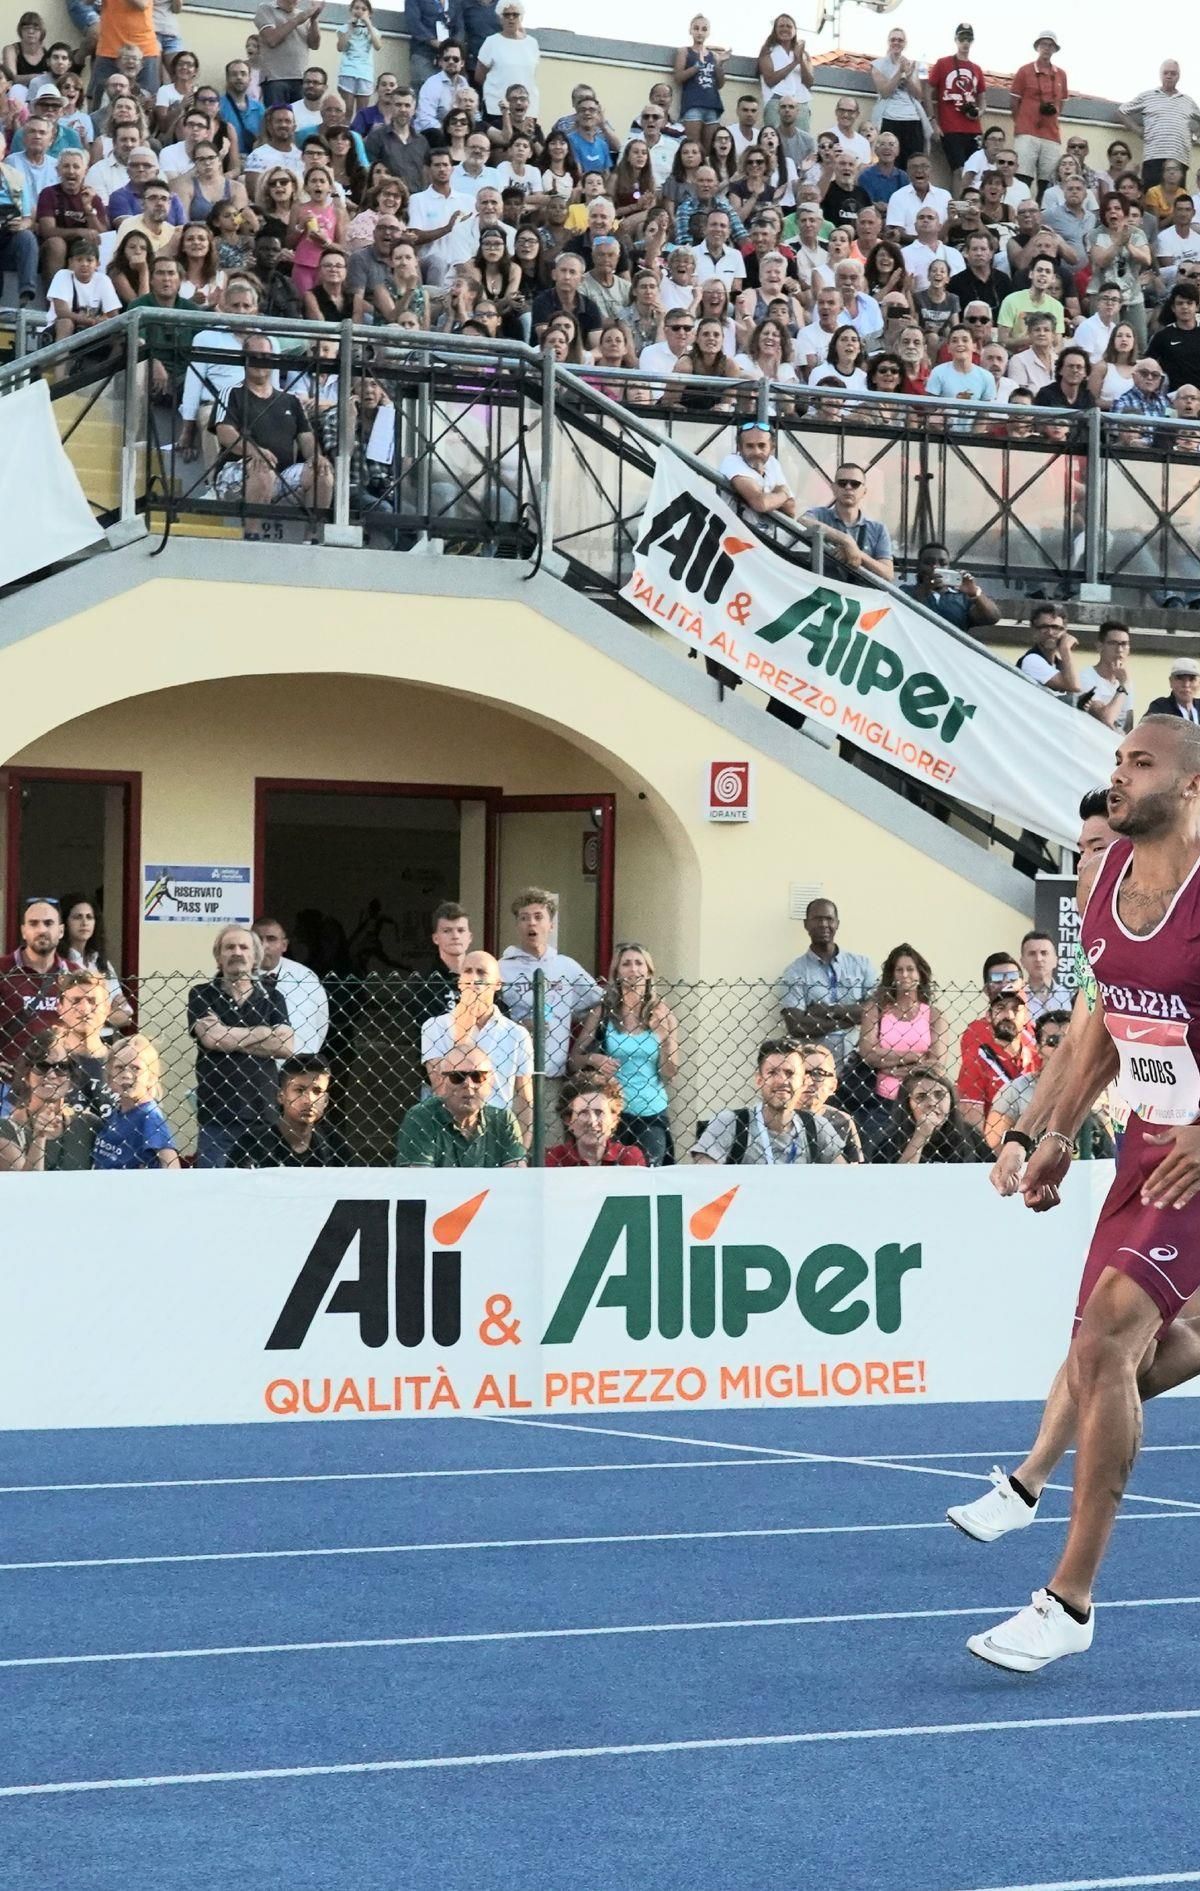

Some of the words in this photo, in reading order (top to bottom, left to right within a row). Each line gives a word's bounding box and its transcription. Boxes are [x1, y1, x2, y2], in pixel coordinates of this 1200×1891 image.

[726, 592, 752, 626] &
[708, 631, 740, 663] AL
[744, 652, 837, 719] PREZZO
[841, 705, 957, 785] MIGLIORE!
[709, 810, 748, 819] IDRANTE
[173, 886, 223, 899] RISERVATO
[177, 901, 202, 914] PASS
[204, 902, 220, 914] VIP
[1098, 980, 1192, 1020] POLIZIA
[478, 1293, 521, 1346] &
[264, 1365, 460, 1414] QUALITÀ
[473, 1374, 532, 1408] AL
[544, 1364, 708, 1408] PREZZO
[720, 1360, 927, 1400] MIGLIORE!
